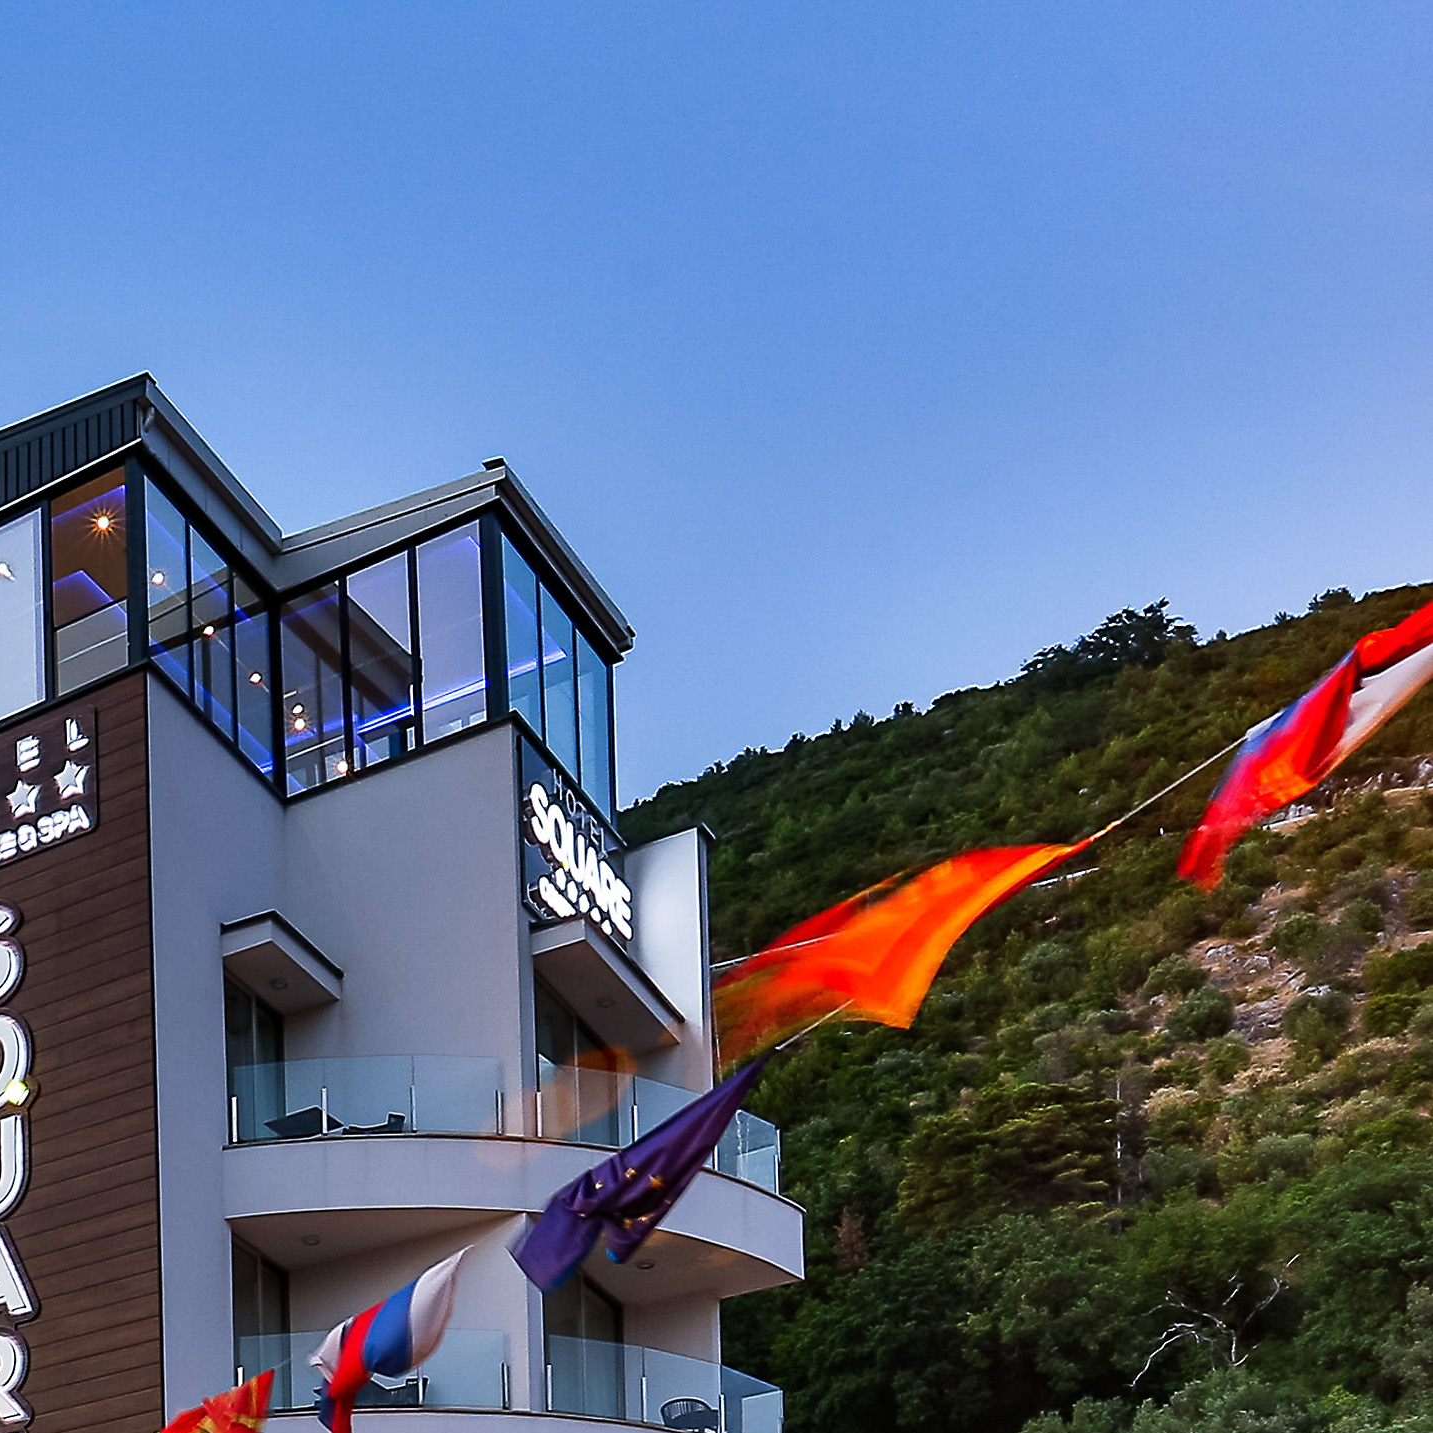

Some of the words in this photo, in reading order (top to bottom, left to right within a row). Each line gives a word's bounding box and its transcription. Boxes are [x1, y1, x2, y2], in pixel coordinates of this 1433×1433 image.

[37, 804, 91, 843] SPA
[553, 768, 609, 859] HOTEL
[530, 783, 633, 941] SQUARE
